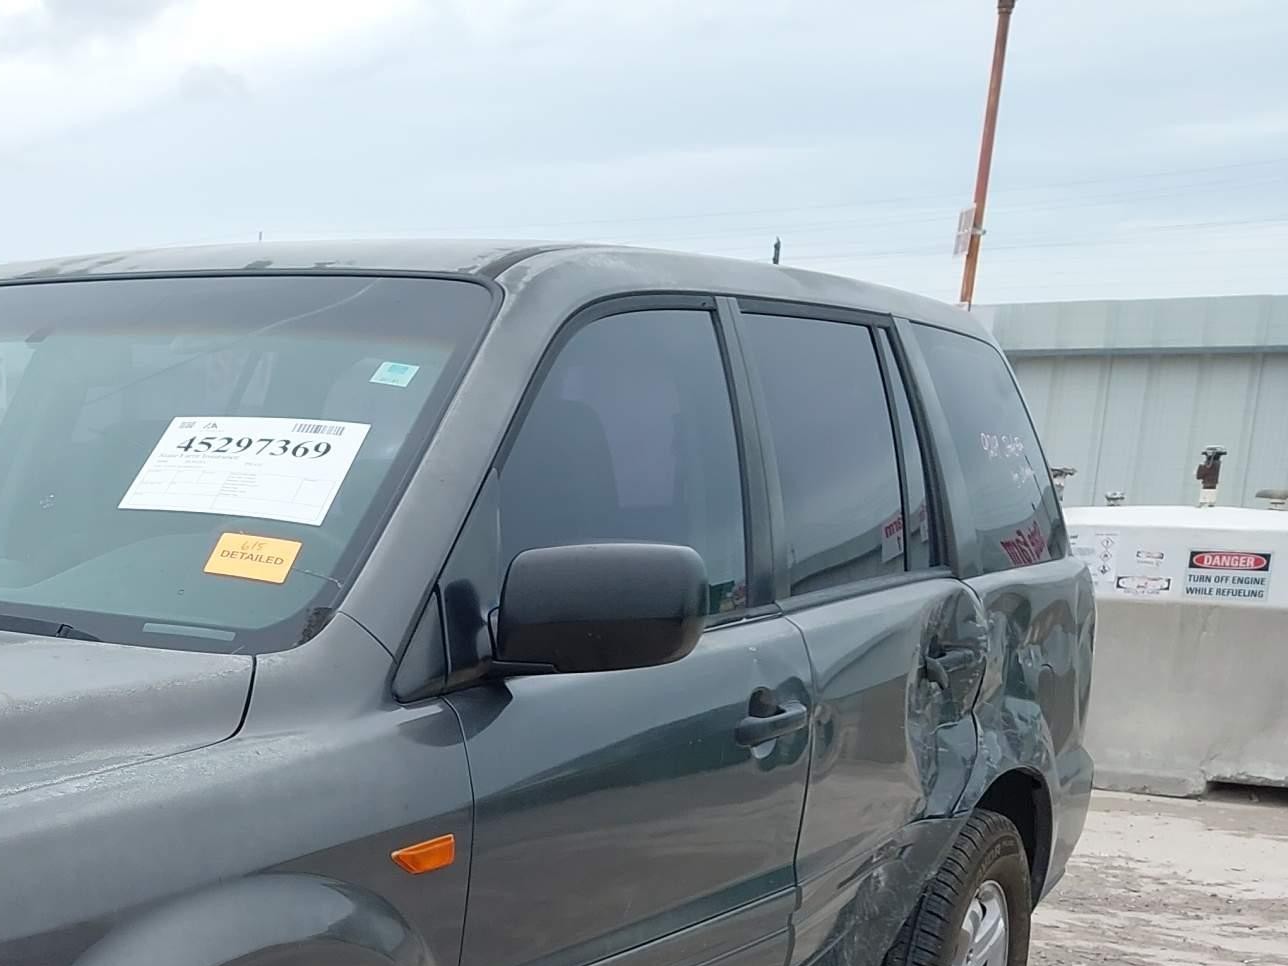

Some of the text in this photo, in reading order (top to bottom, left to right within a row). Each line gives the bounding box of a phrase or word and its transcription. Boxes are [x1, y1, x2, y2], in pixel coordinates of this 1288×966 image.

[177, 436, 332, 459] 45297369
[220, 549, 284, 566] DETAILED
[1203, 554, 1256, 568] DANGER
[1188, 574, 1266, 586] TURN OFF ENGINE
[1185, 587, 1264, 598] WHILE REFUELING
